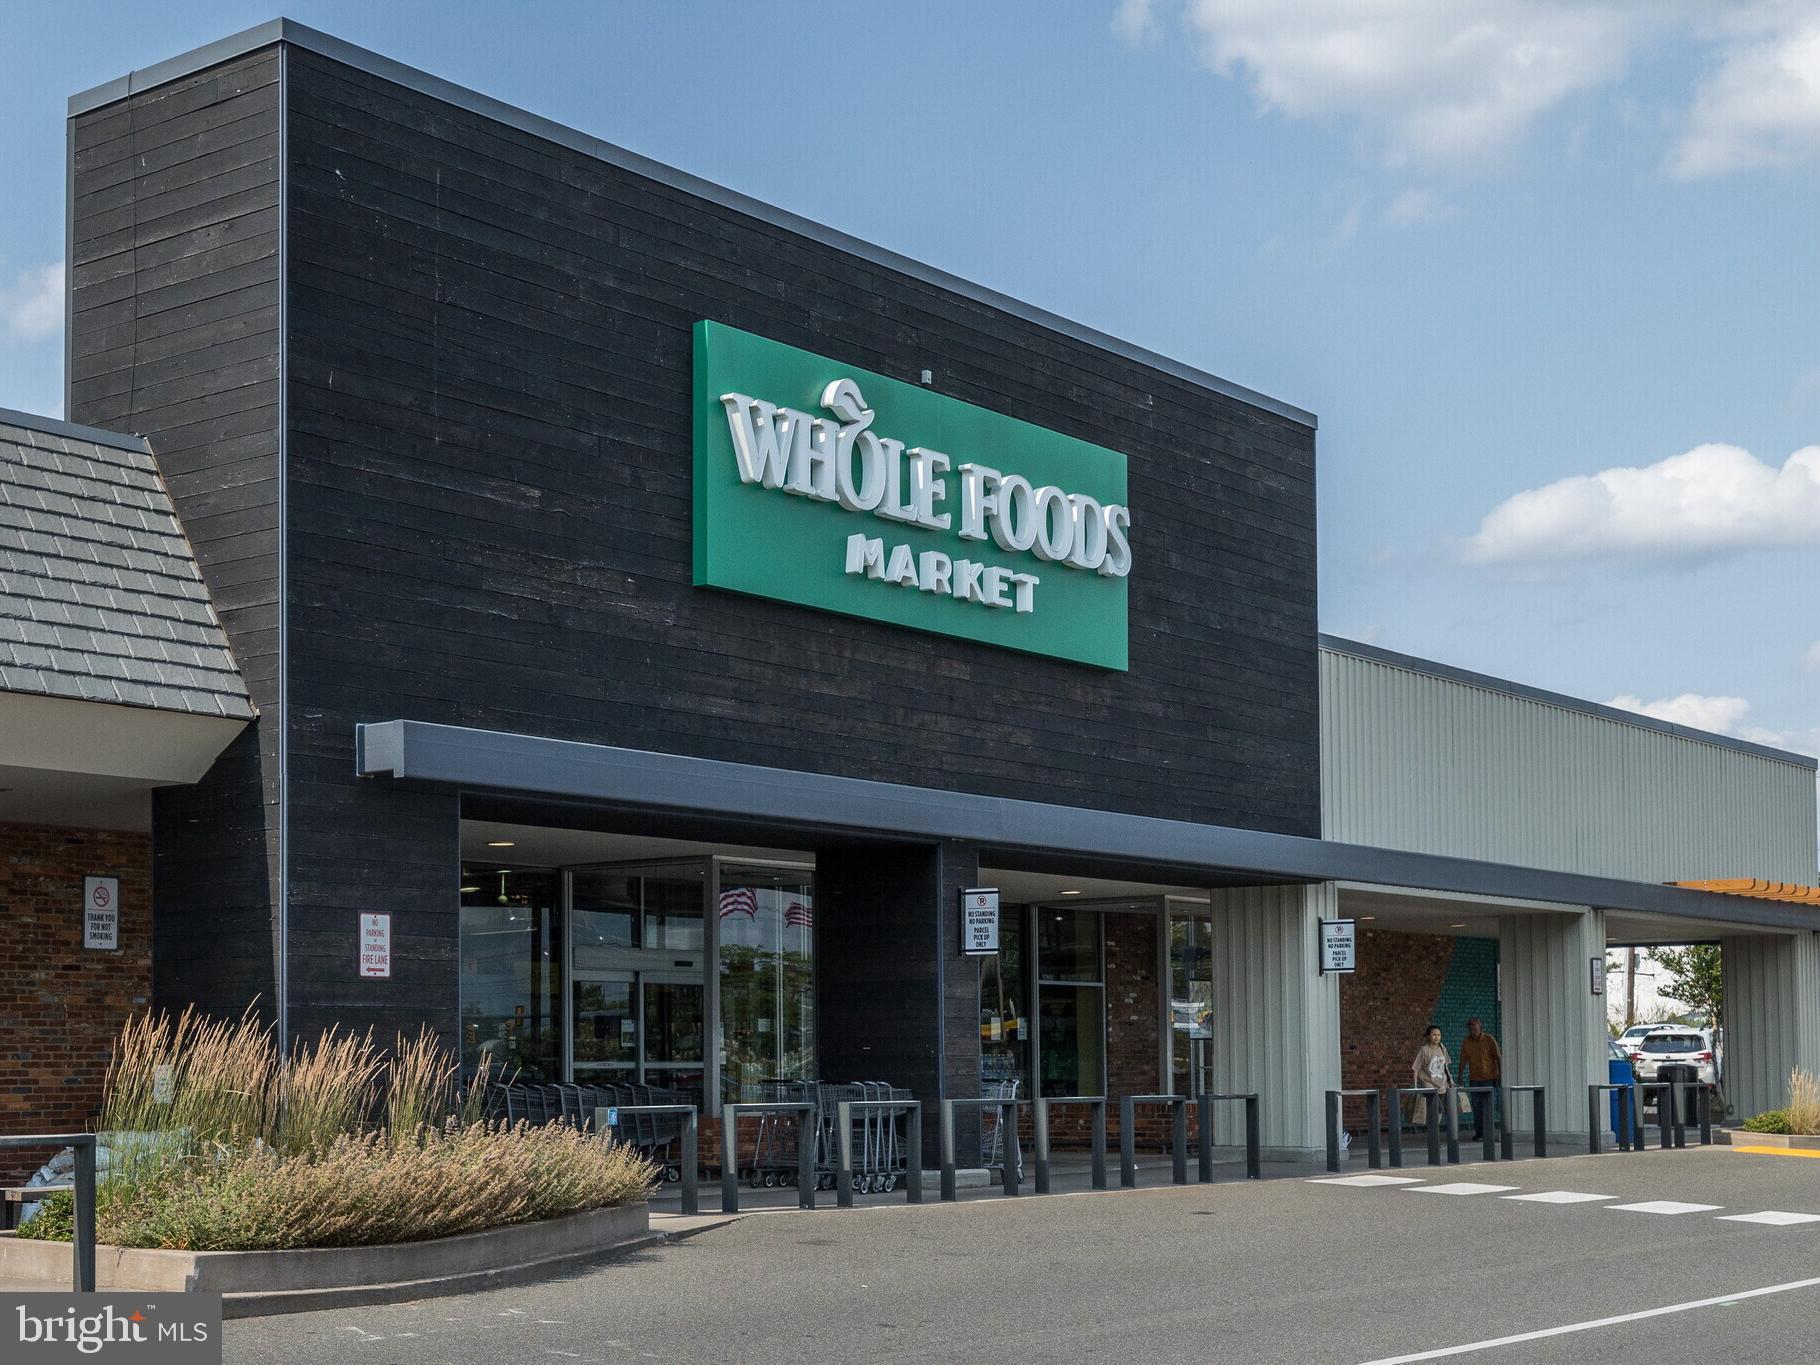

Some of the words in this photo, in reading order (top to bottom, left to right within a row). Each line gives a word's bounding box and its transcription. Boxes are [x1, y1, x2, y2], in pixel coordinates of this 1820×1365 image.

[720, 392, 951, 530] WHOLE
[958, 463, 1132, 577] FOODS
[845, 533, 1039, 613] MARKET
[87, 913, 104, 922] THANK
[105, 914, 116, 922] YOU
[91, 922, 101, 931] FOR
[101, 923, 111, 931] NOT
[90, 932, 113, 941] SMOKING
[366, 929, 385, 938] PARKING
[365, 944, 386, 952] STANDING
[362, 954, 374, 965] FIRE
[375, 954, 389, 965] LANE
